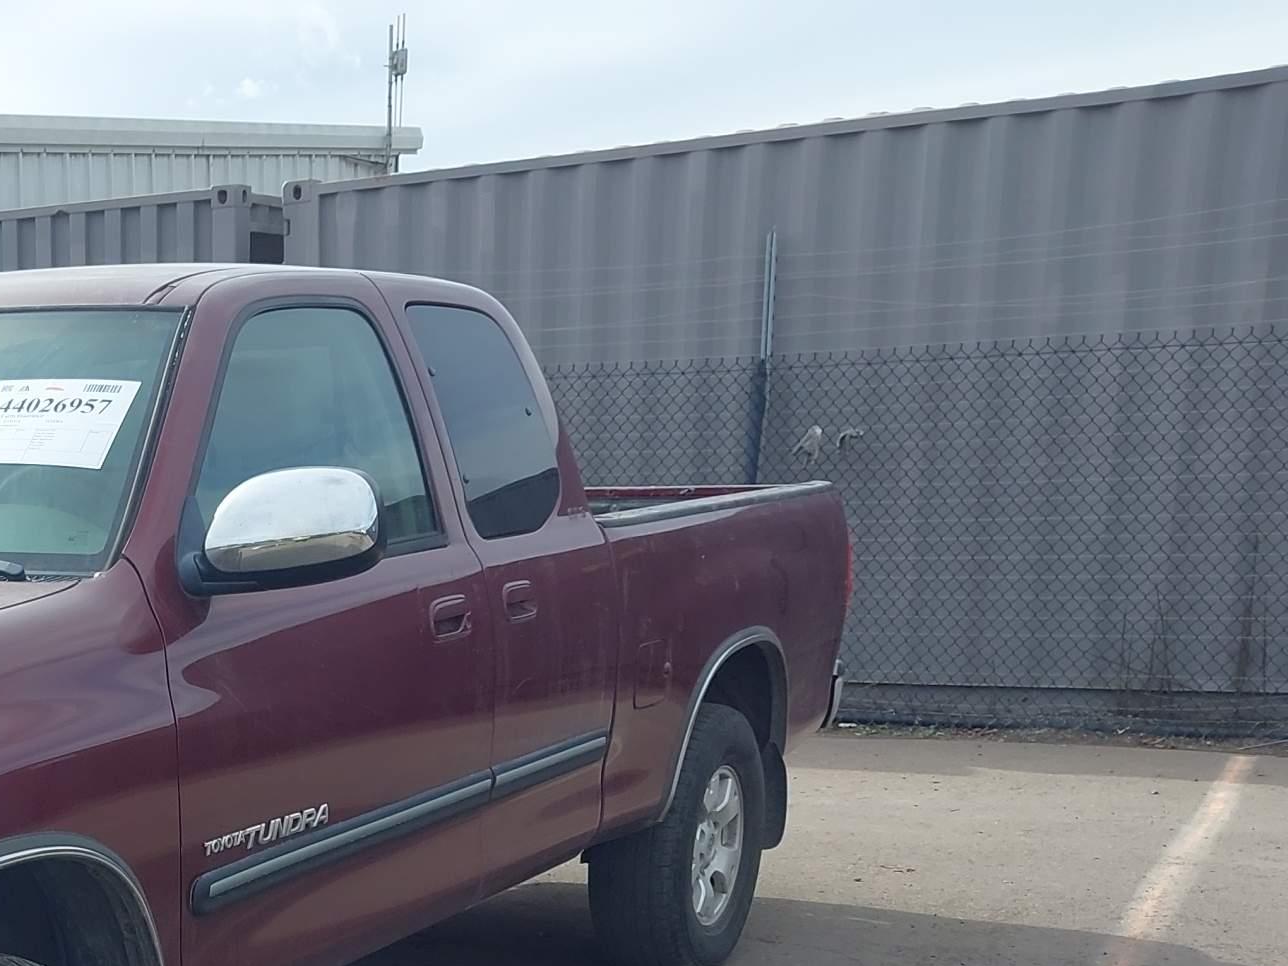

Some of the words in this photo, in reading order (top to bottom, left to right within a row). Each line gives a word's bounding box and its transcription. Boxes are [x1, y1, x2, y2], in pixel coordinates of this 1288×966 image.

[0, 398, 112, 415] 44026957
[203, 830, 247, 857] TOYOTA
[245, 802, 330, 850] TUNDRA
